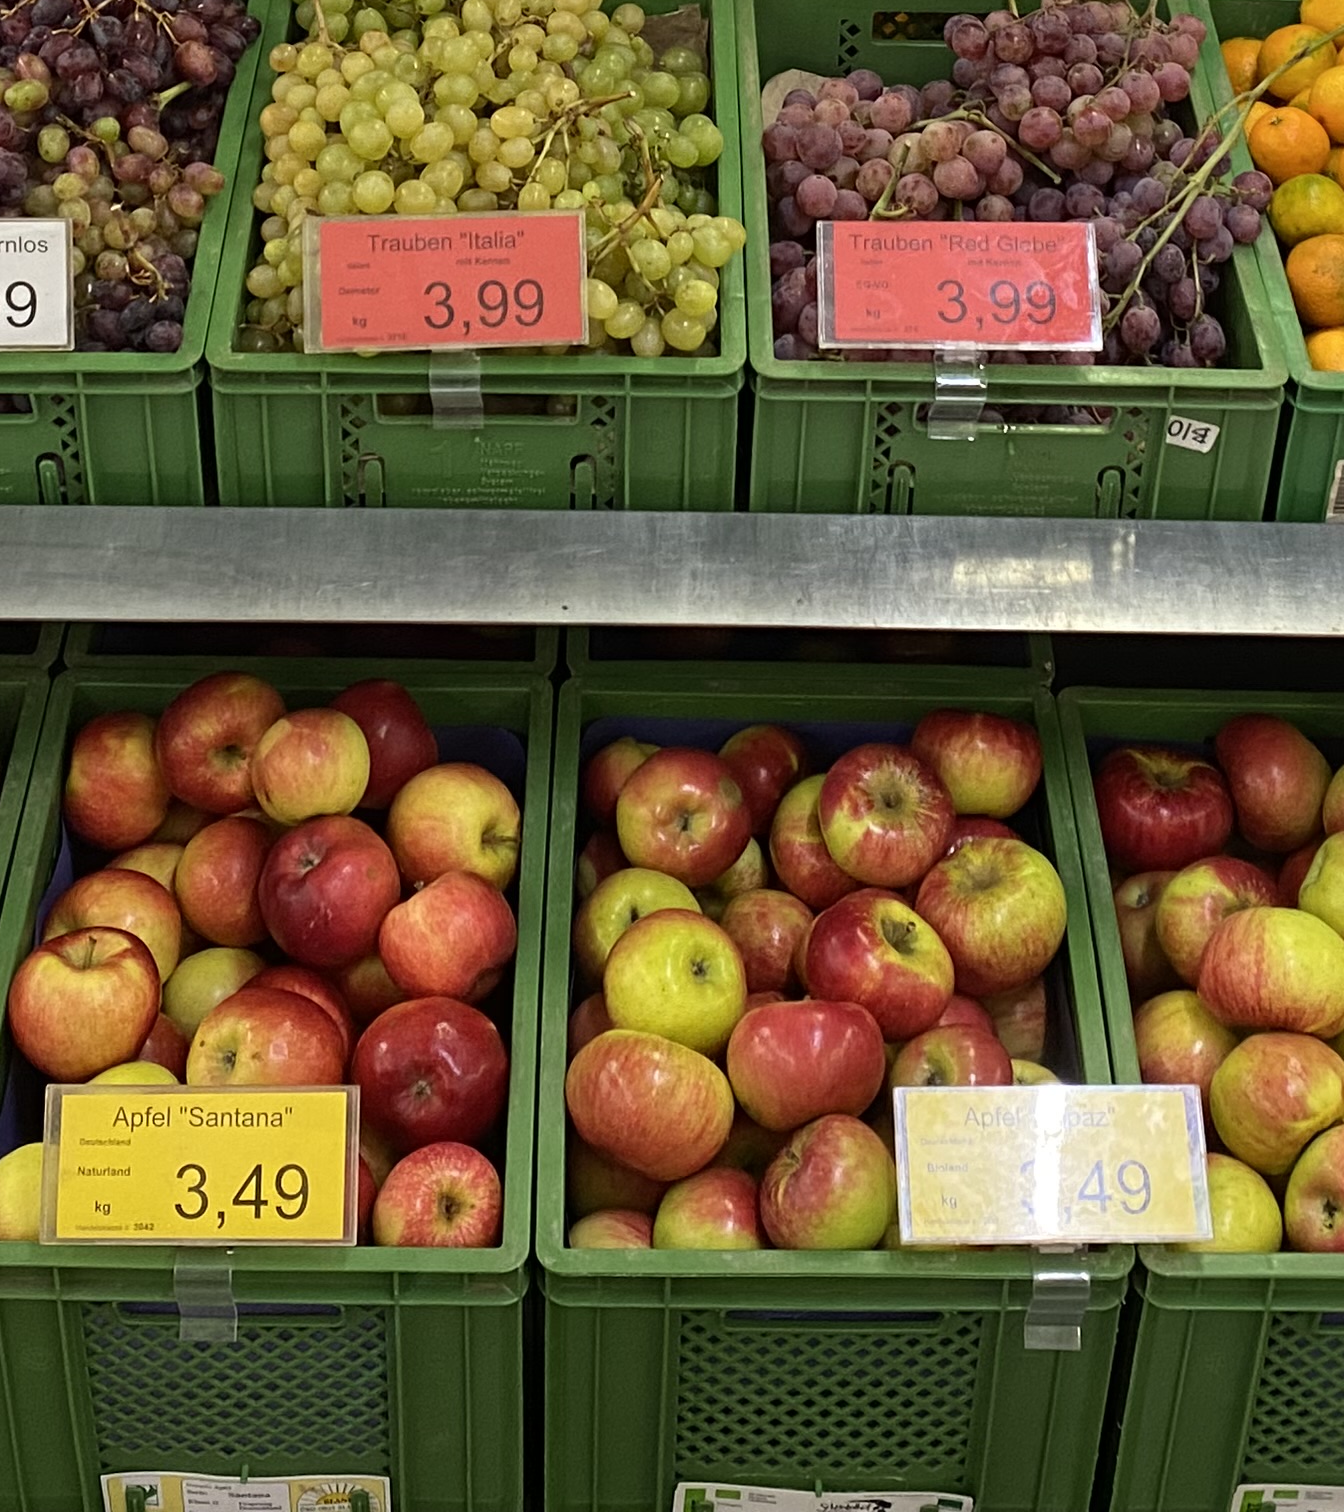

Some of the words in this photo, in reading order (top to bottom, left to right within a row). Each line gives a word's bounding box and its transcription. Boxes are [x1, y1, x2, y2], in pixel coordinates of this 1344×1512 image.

[367, 234, 452, 252] Trauben
[460, 231, 525, 250] "Italia"
[848, 233, 933, 252] Trauben
[940, 234, 990, 252] "Red
[423, 279, 544, 335] 3,99
[865, 307, 880, 320] kg
[937, 280, 1056, 330] 3,99
[352, 316, 367, 328] kg
[1167, 420, 1212, 444] BIO
[112, 1106, 171, 1133] Apfel
[179, 1106, 293, 1128] "Santana"
[964, 1107, 1021, 1128] Apfel
[1030, 1107, 1115, 1128] "paz"
[77, 1165, 131, 1177] Naturland
[927, 1163, 969, 1173] Bioland
[174, 1163, 309, 1229] 3,49
[941, 1195, 958, 1209] kg
[94, 1200, 112, 1216] kg
